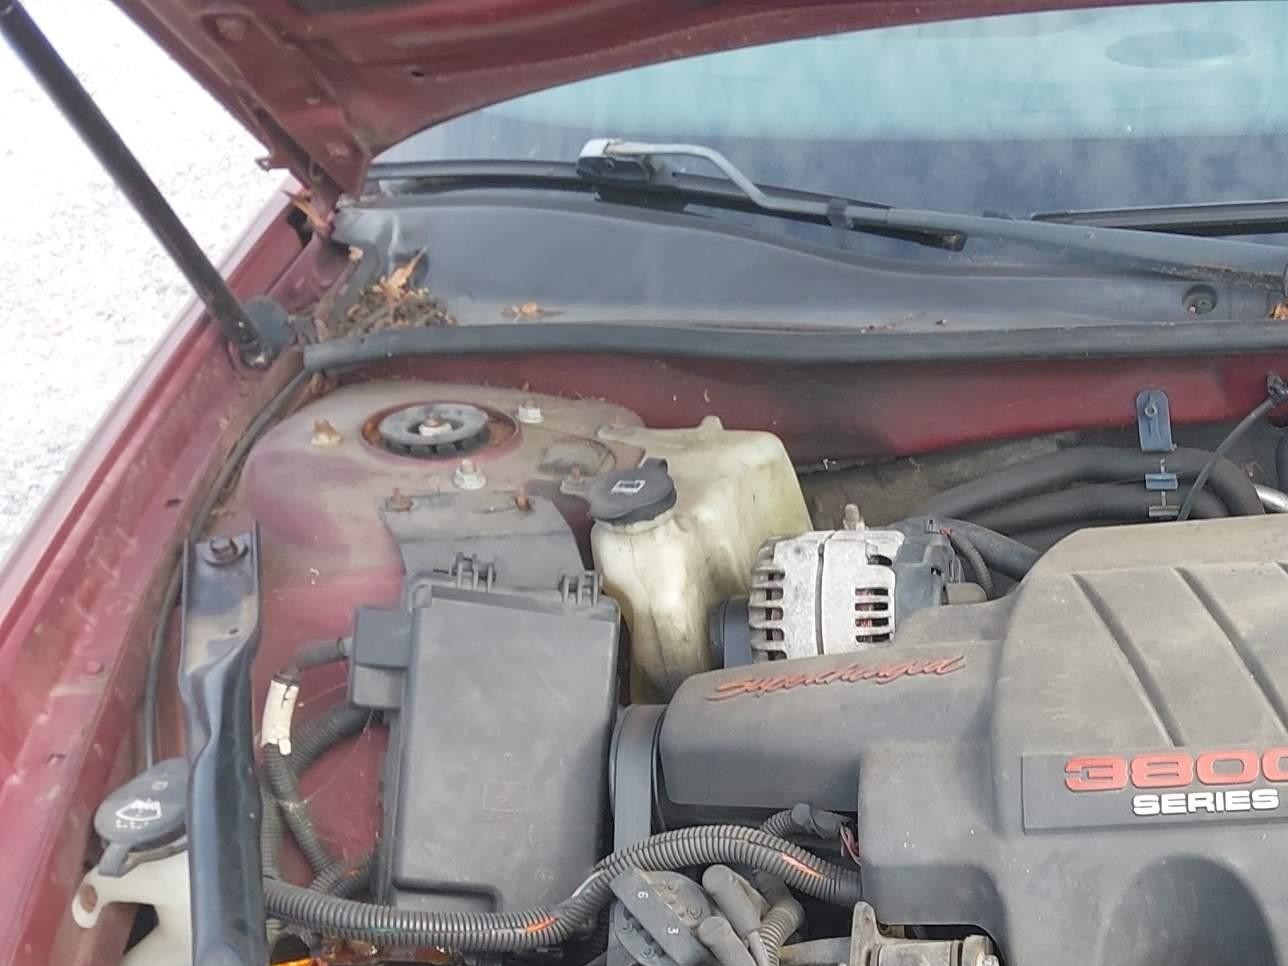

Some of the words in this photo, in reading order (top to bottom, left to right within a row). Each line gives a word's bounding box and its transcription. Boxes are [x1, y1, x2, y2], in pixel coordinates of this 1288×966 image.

[1132, 788, 1279, 816] SERIES
[637, 890, 649, 899] 6
[667, 926, 679, 935] 3
